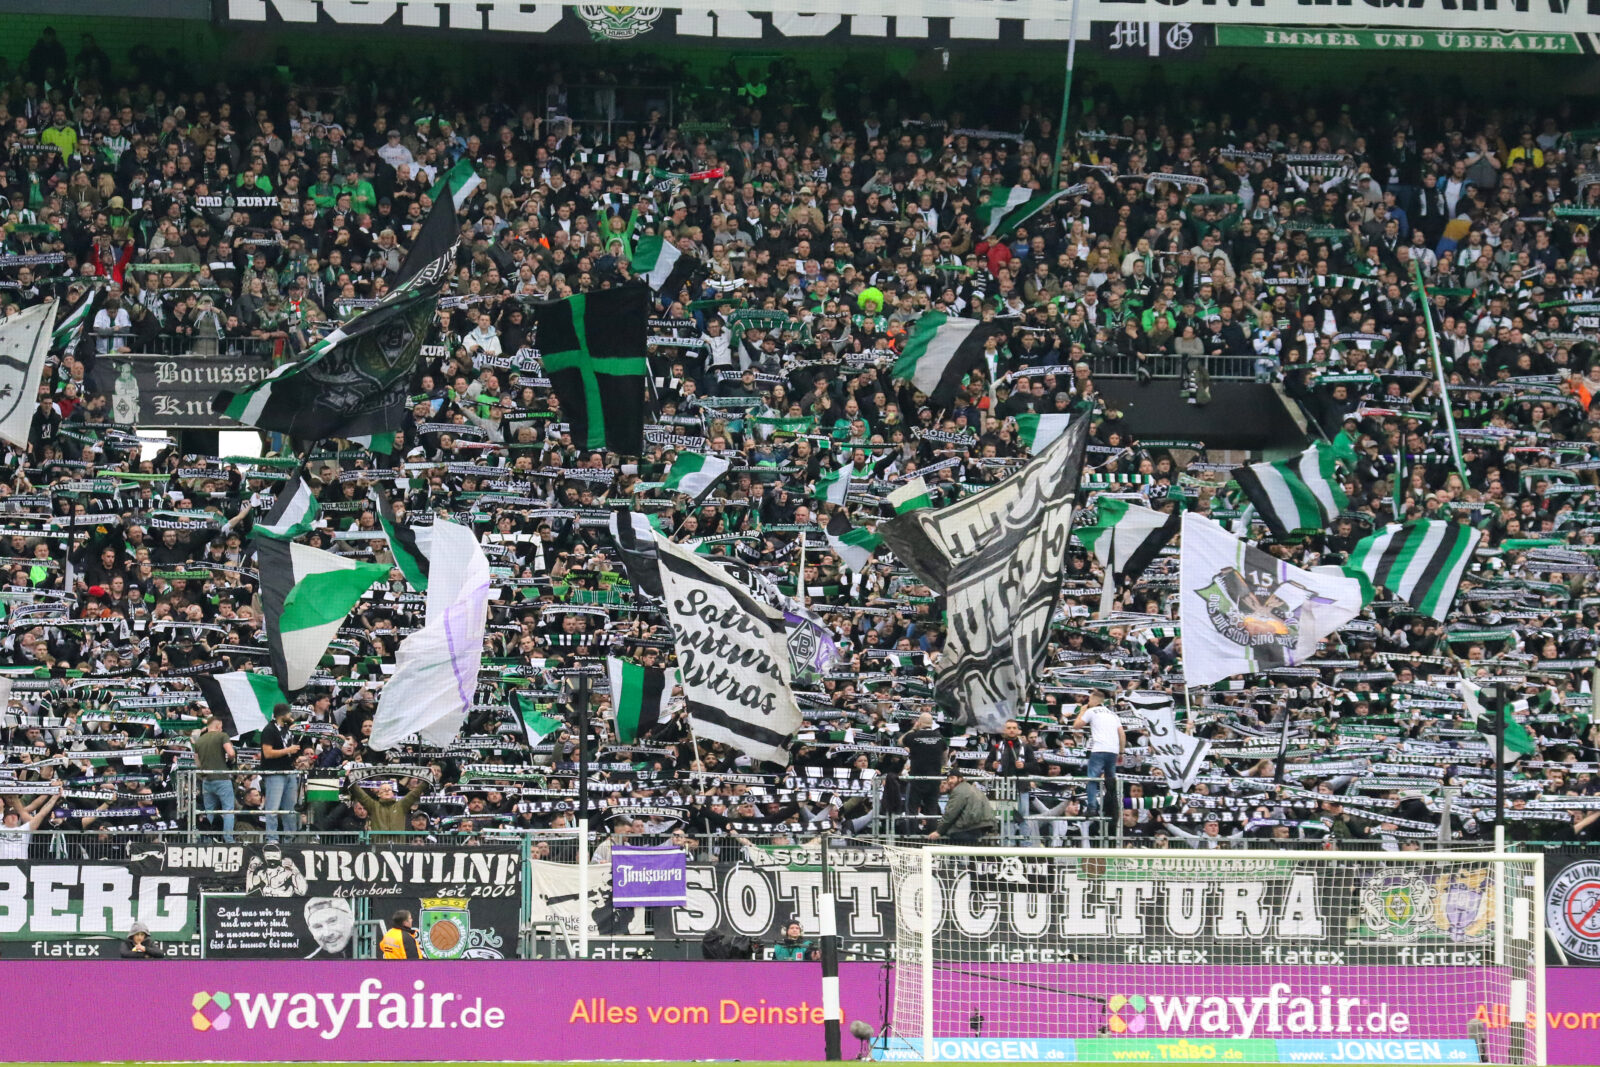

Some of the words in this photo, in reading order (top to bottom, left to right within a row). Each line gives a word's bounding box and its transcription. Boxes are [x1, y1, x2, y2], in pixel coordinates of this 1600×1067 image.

[1264, 30, 1361, 46] IMMER
[1375, 33, 1425, 48] UND
[1437, 32, 1567, 51] ÜBERALL!
[236, 196, 278, 207] KURVE
[154, 361, 271, 386] Borussen
[649, 431, 704, 446] BORUSSIA
[1249, 569, 1274, 588] 15
[168, 661, 223, 675] BORUSSIA
[611, 806, 683, 818] SOTTOCULTURA
[733, 819, 832, 832] ULTRAS
[167, 846, 244, 868] BANDA
[300, 848, 520, 885] FRONTLINE
[214, 863, 240, 873] SUD
[436, 885, 465, 898] seit
[471, 884, 516, 897] 2006
[216, 907, 240, 919] Egal
[258, 908, 274, 917] wir
[220, 917, 239, 928] und
[240, 920, 251, 928] wo
[254, 918, 269, 928] wir
[32, 940, 100, 957] flatex
[209, 938, 225, 949] bist
[226, 939, 238, 949] du
[240, 940, 268, 949] immer
[269, 938, 281, 949] bei
[1565, 934, 1579, 950] IN
[1578, 941, 1599, 955] DER
[1124, 944, 1209, 964] flatex
[1261, 946, 1345, 965] flatex
[1398, 947, 1482, 966] flatex
[569, 998, 638, 1024] Alles
[646, 1005, 709, 1024] vom
[1474, 1003, 1537, 1029] Alls
[930, 1040, 1039, 1060] JONGEN
[1289, 1050, 1328, 1061] www.
[1330, 1041, 1442, 1060] JONGEN
